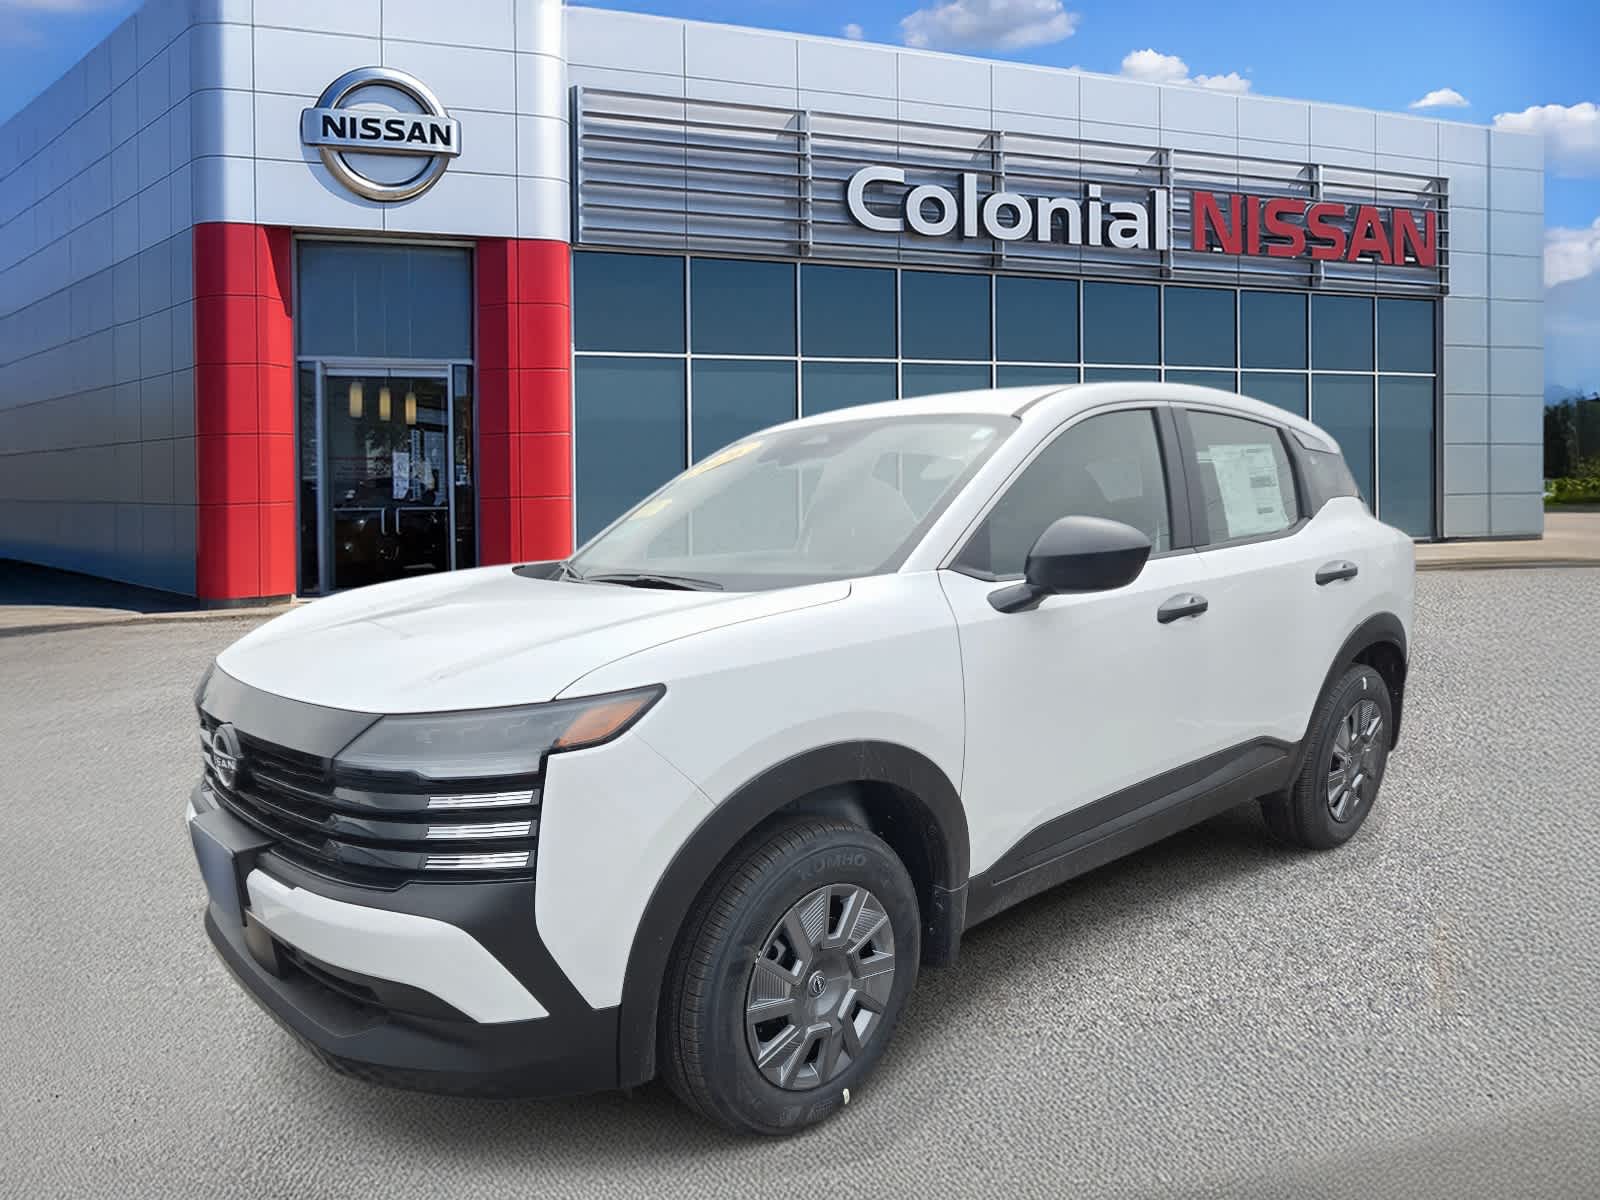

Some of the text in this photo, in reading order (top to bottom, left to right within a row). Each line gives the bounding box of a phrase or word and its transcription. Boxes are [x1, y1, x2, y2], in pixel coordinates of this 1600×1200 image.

[322, 115, 451, 146] NISSAN
[847, 165, 1436, 267] Colonial NISSAN
